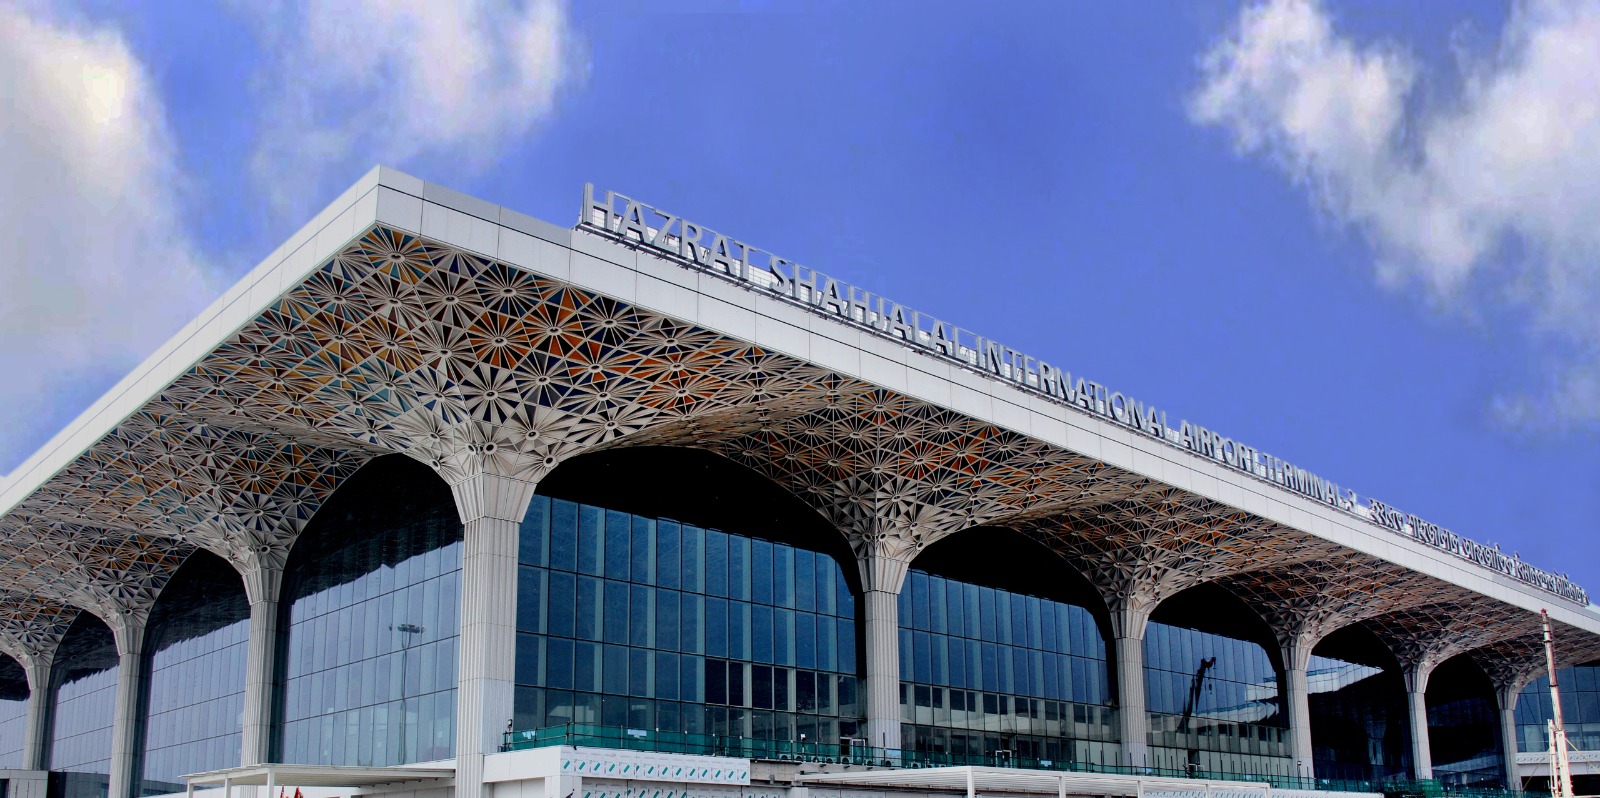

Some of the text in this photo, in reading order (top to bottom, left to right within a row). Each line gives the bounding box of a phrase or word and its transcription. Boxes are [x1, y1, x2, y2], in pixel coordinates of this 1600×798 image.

[582, 181, 757, 281] HAZRAT
[769, 254, 970, 363] SHAHJALAL
[976, 335, 1175, 440] INTERNATIONAL
[1179, 419, 1259, 475] AIRPORT
